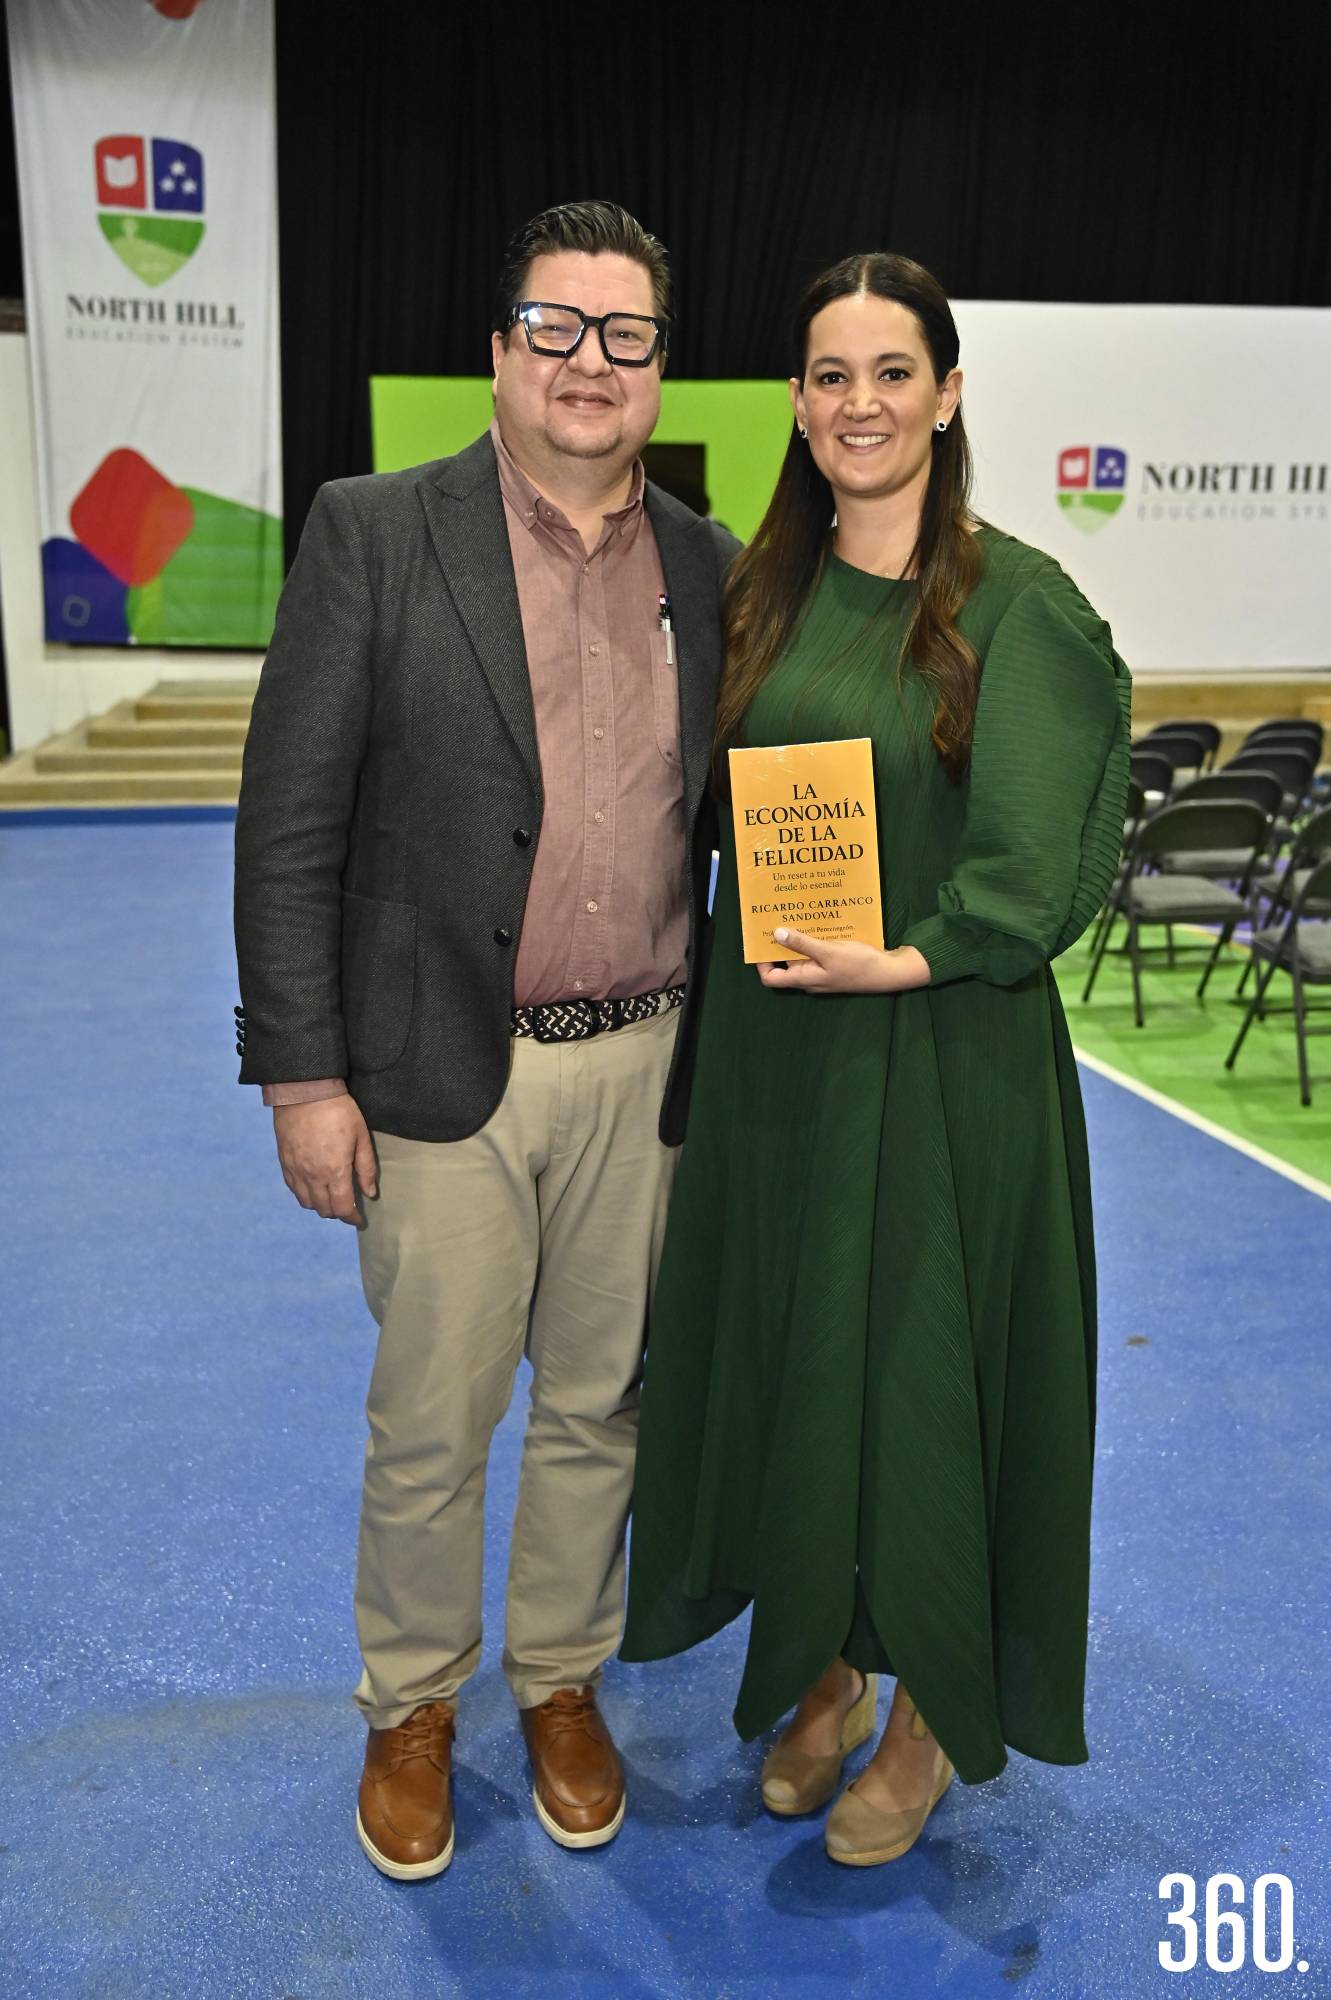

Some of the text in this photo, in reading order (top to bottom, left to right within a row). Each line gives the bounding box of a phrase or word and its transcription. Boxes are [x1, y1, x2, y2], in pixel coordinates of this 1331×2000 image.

[67, 294, 244, 330] NORTH HILL
[1141, 463, 1331, 493] NORTH HI
[1137, 503, 1275, 520] EDUCATION
[792, 783, 818, 800] LA
[744, 798, 866, 826] ECONOMÍA
[778, 824, 838, 844] DE LA
[753, 843, 864, 867] FELICIDAD
[773, 873, 786, 881] Un
[787, 871, 807, 880] reset
[827, 868, 846, 877] vida
[774, 879, 843, 892] desde lo esencial
[752, 897, 874, 913] RICARDO CARRANCO
[782, 910, 842, 922] SANDOVAL
